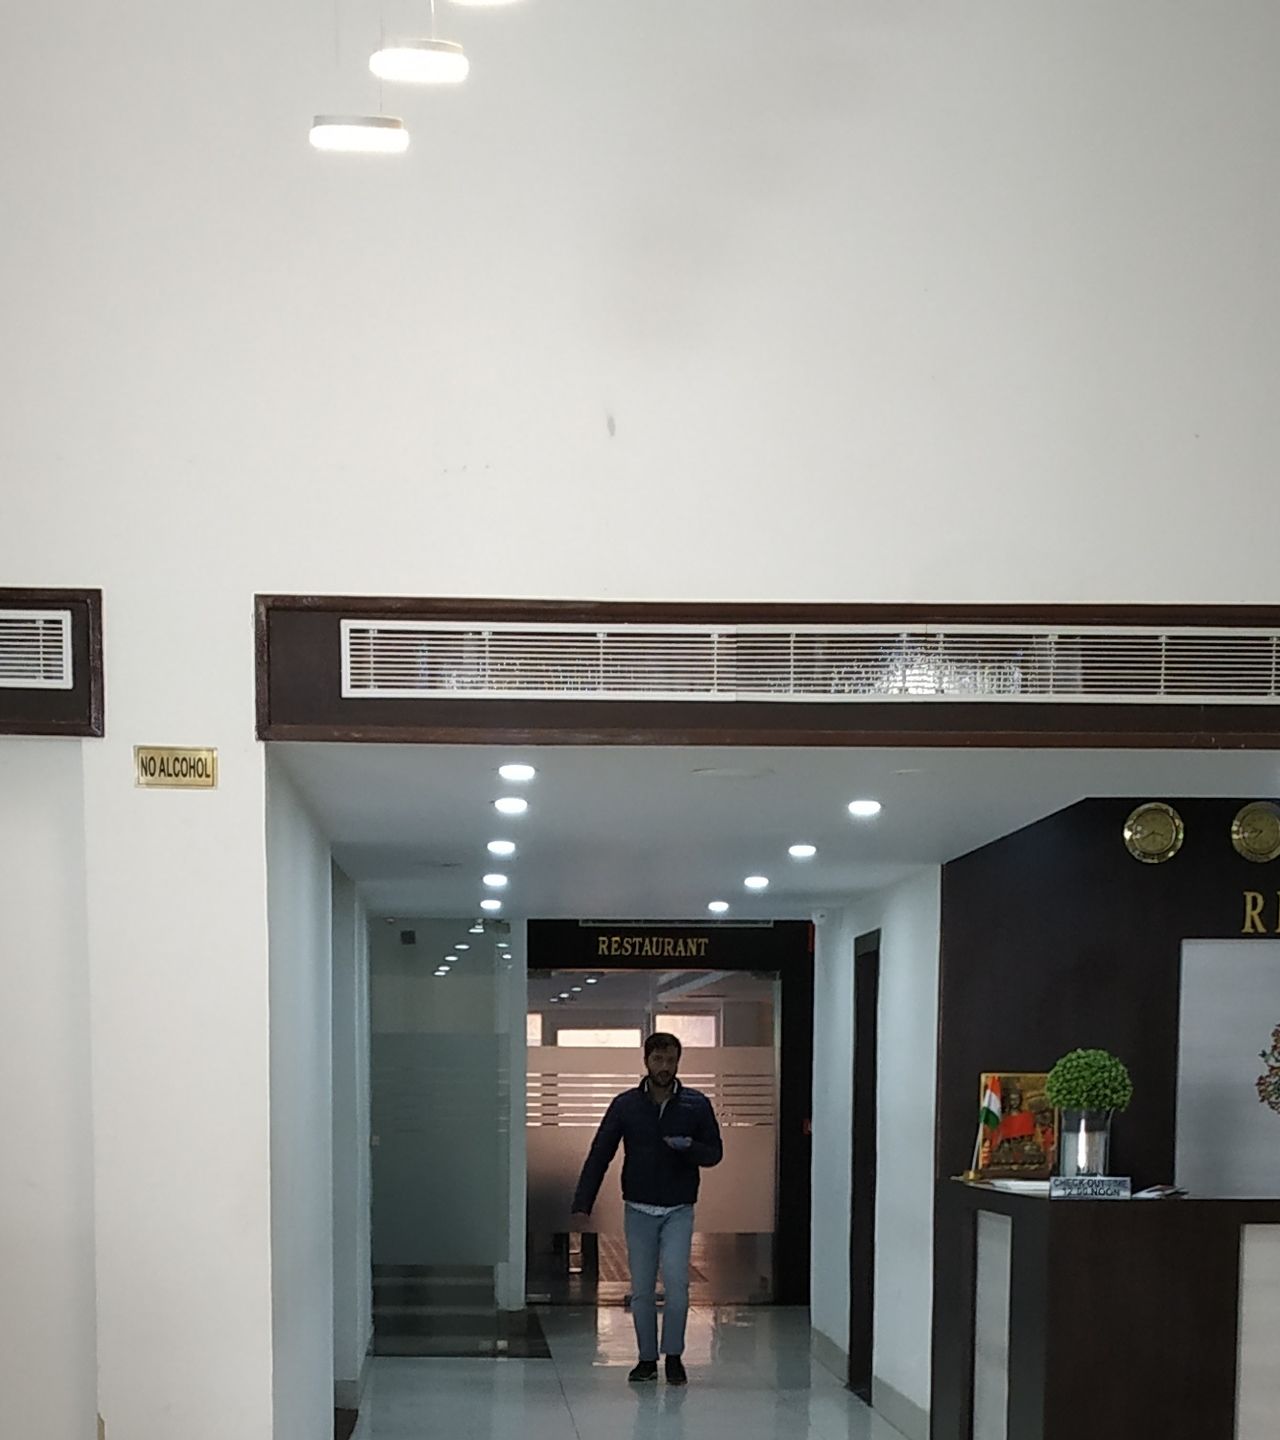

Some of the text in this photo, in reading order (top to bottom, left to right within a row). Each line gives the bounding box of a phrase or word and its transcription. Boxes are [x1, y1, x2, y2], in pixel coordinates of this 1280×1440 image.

[140, 756, 211, 778] NO ALCOHOL
[597, 936, 710, 957] RESTAURANT
